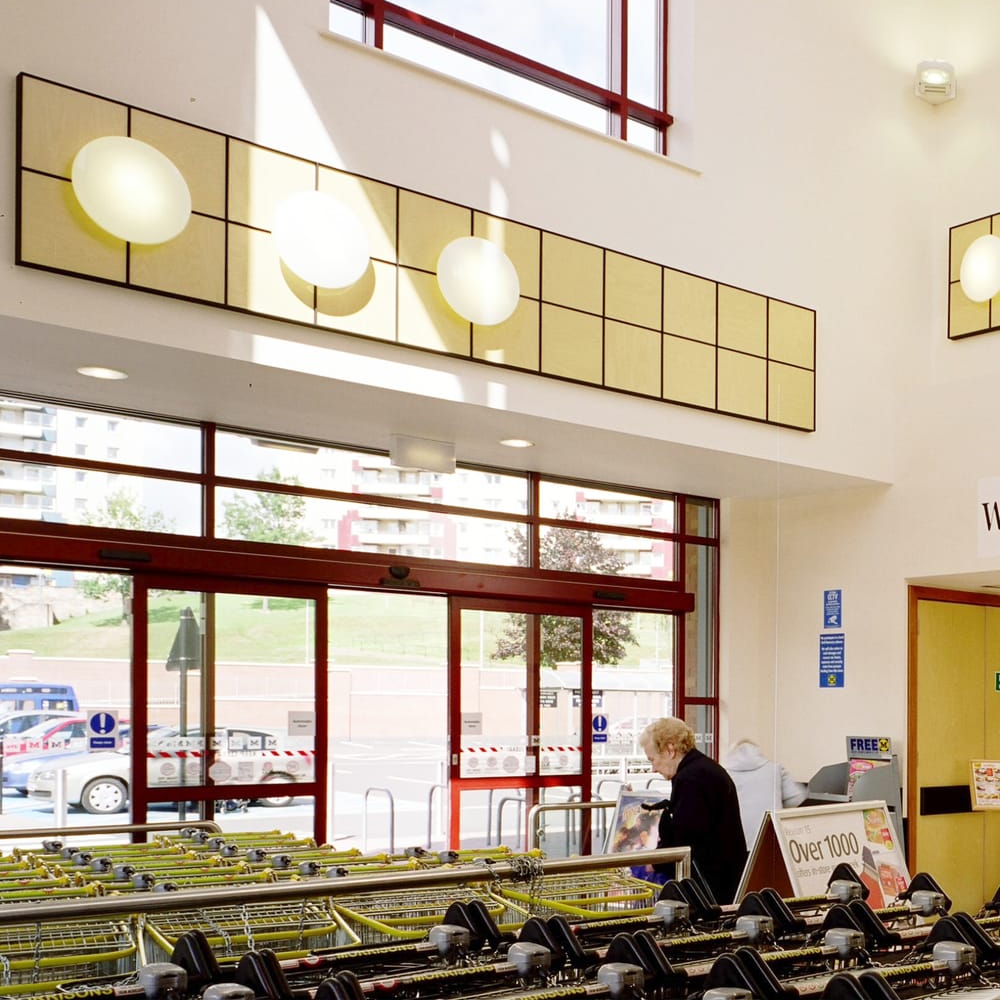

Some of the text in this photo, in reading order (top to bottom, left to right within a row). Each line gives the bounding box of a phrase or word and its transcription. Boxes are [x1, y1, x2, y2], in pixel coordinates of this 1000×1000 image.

[850, 738, 878, 750] FREE
[789, 832, 859, 864] Over 1000
